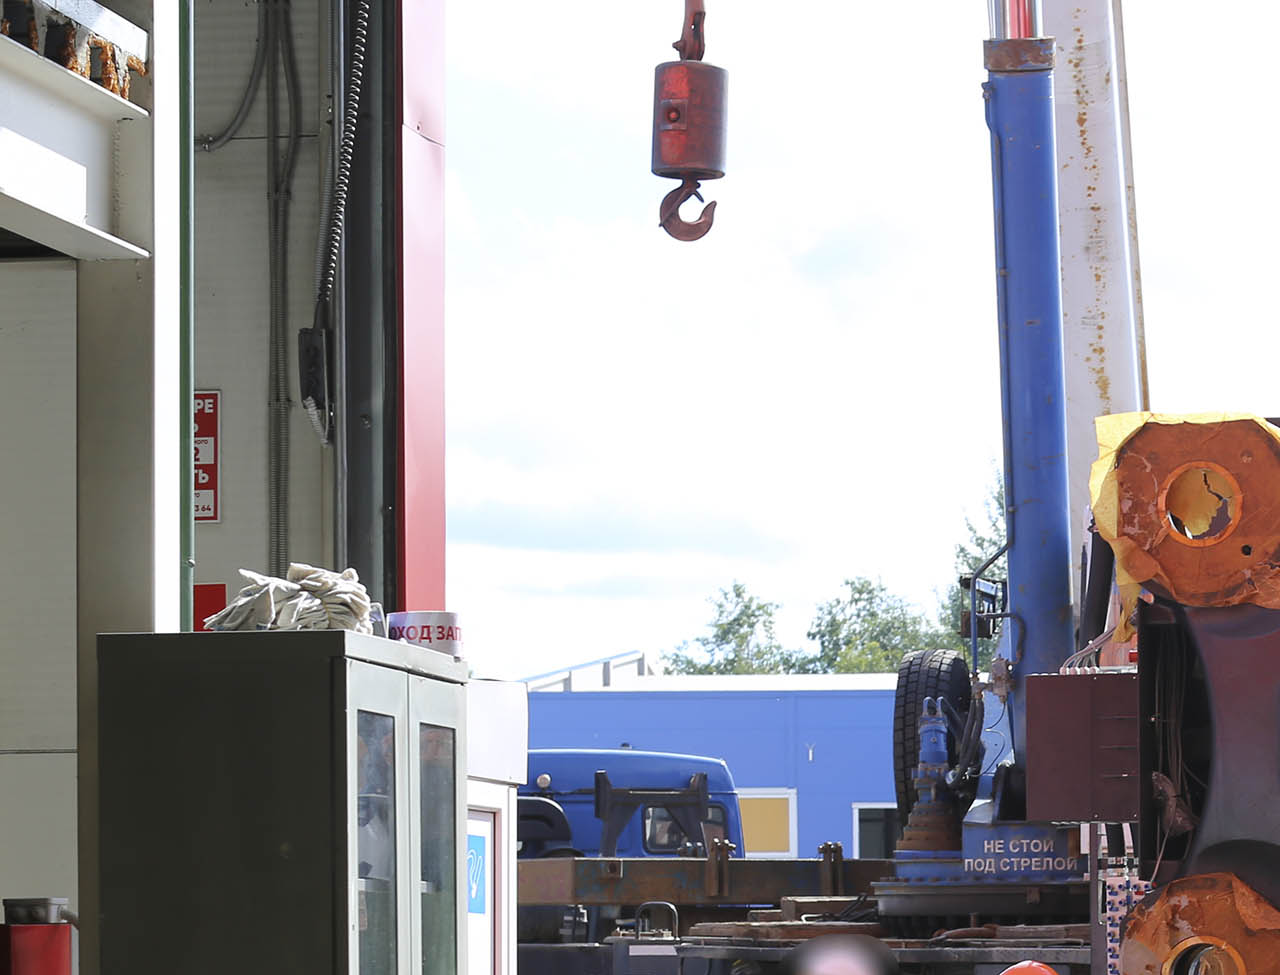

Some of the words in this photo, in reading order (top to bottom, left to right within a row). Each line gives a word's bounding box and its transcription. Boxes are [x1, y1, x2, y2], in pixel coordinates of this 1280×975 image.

[984, 840, 1005, 853] НЕ
[964, 858, 996, 874] ПОД
[1000, 856, 1077, 871] СТРЕЛОЙ
